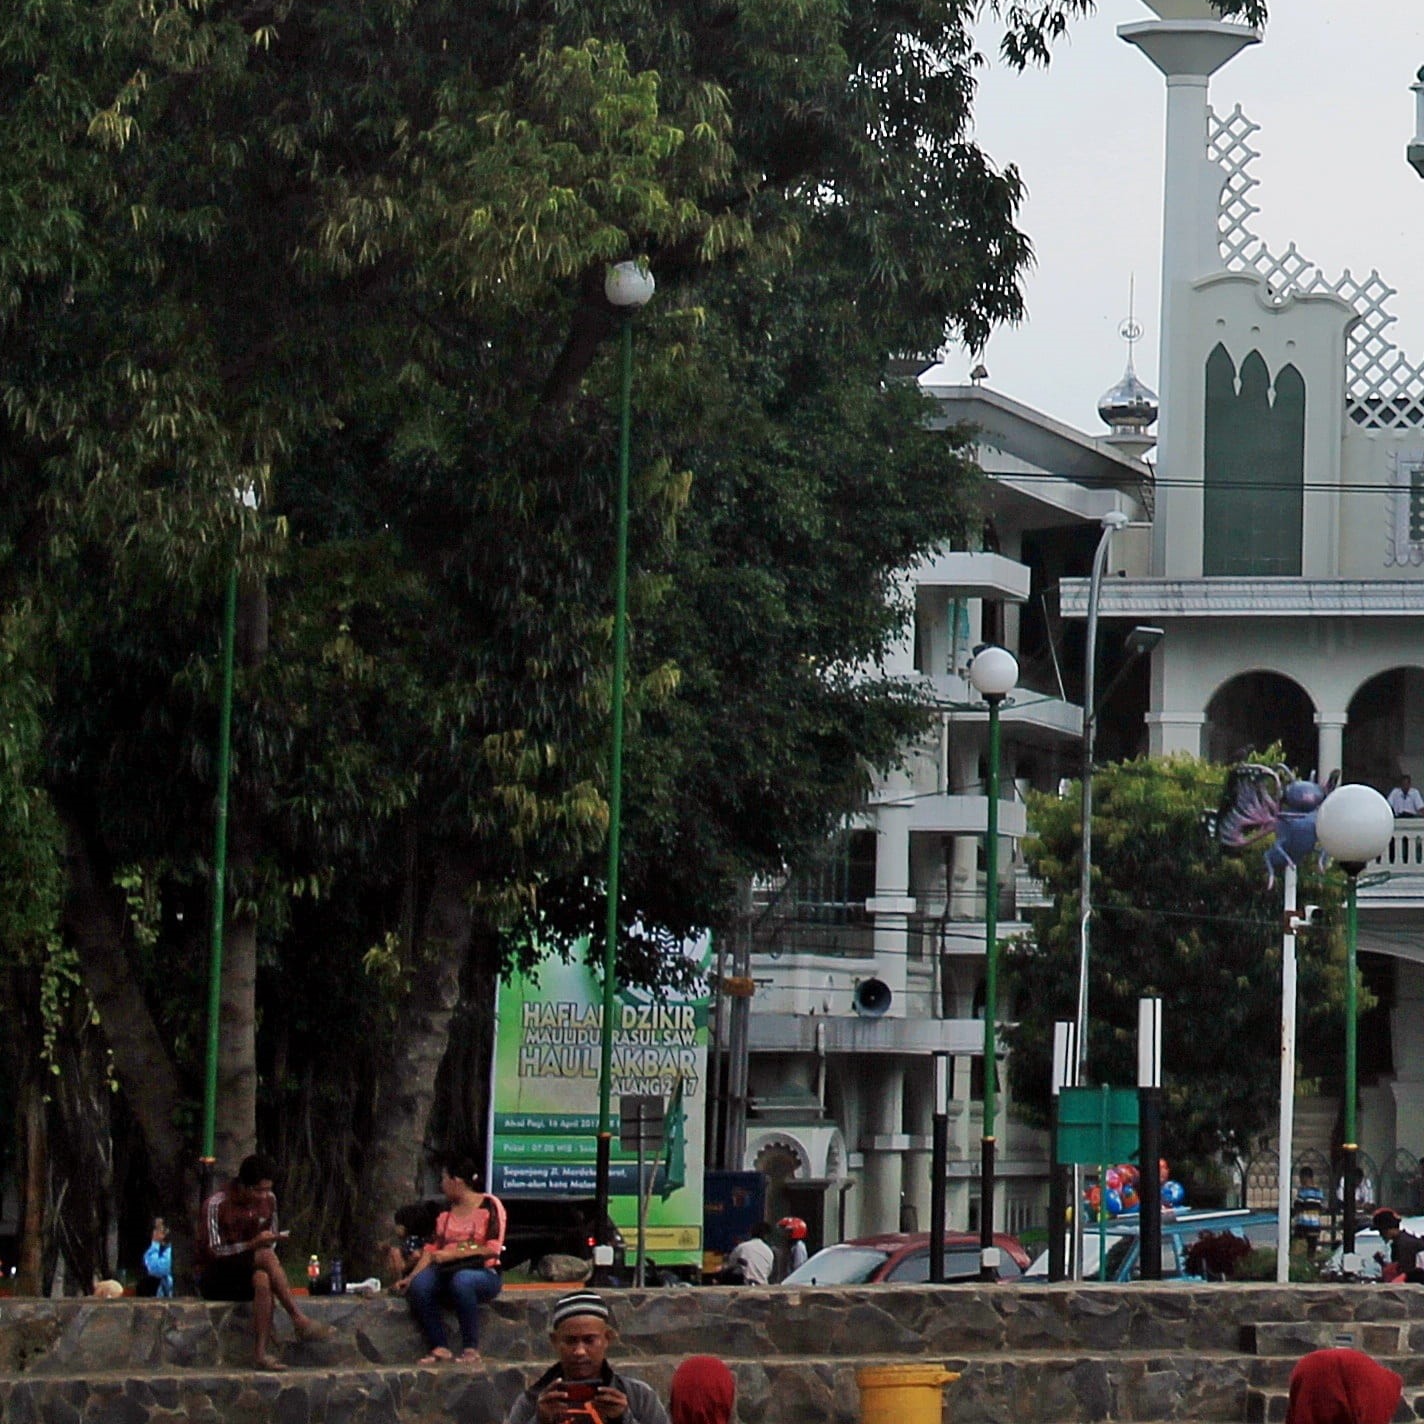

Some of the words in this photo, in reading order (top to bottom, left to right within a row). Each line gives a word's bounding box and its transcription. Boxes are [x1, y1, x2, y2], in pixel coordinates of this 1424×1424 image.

[612, 1029, 659, 1047] RASUL
[663, 1030, 697, 1047] SAW.
[520, 1045, 598, 1077] HAUL
[611, 1047, 698, 1080] AKBAR
[603, 1077, 661, 1096] ALANG
[662, 1077, 698, 1096] 217
[559, 1119, 579, 1129] April
